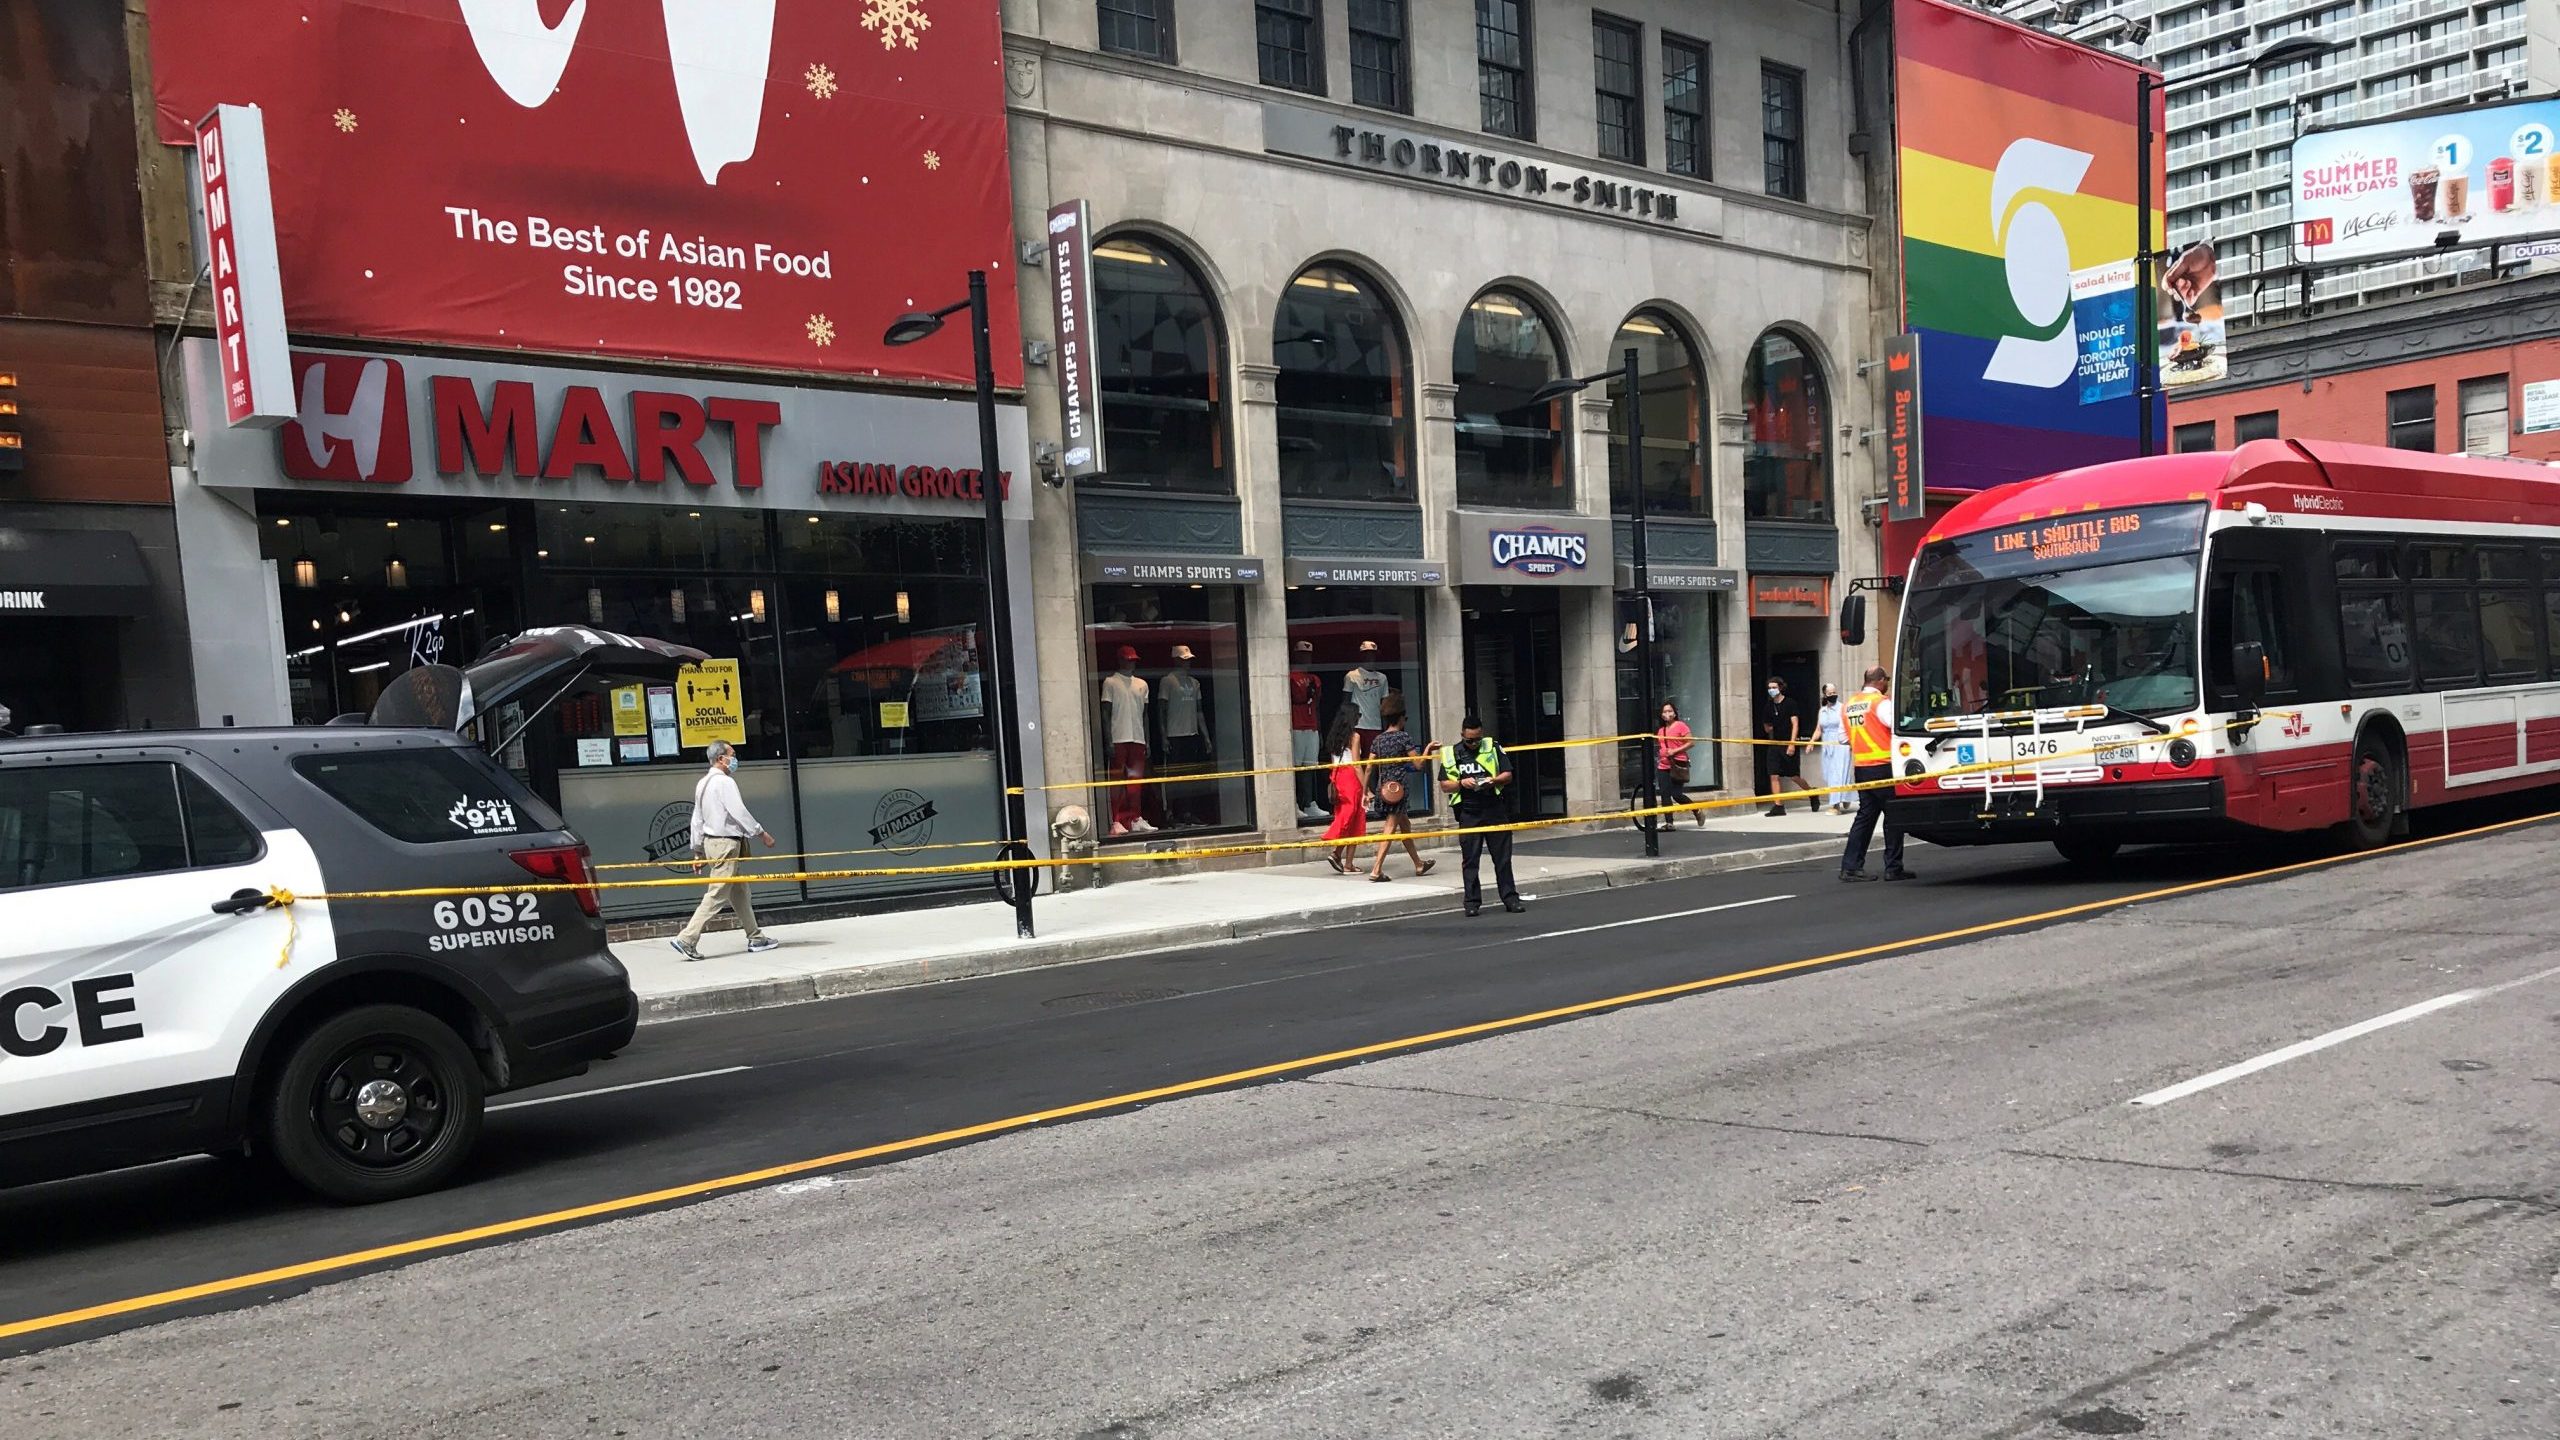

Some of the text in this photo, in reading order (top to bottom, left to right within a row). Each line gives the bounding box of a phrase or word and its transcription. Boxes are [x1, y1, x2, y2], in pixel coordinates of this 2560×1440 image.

[1330, 125, 1680, 221] THORNTON-SMITH
[2303, 157, 2398, 187] SUMMER
[2303, 176, 2399, 200] DRINK DAYS
[444, 206, 832, 279] The Best of Asian Food
[209, 186, 240, 373] MART
[563, 264, 743, 310] Since 1982
[2075, 270, 2131, 290] salad king
[1057, 240, 1081, 439] CHAMPS SPORTS
[2079, 324, 2126, 343] INDULGE
[2098, 339, 2111, 350] IN
[2079, 344, 2136, 365] TORONTO'S
[2078, 358, 2127, 376] CULTURAL
[2097, 368, 2130, 384] HEART
[428, 375, 782, 489] MART
[1892, 390, 1912, 508] salad king
[819, 461, 1013, 501] ASIAN GROCEY
[2268, 514, 2284, 526] 3476
[1994, 513, 2141, 552] LINE 1 SHUTTLE BUS
[1493, 533, 1586, 565] CHAMPS
[2033, 537, 2101, 560] SOUTHBOUND
[1133, 565, 1232, 579] CHAMPS SPORTS
[1332, 569, 1417, 582] CHAMPS SPORTS
[1527, 563, 1555, 573] SPORTS
[1652, 575, 1717, 586] CHAMPS SPORTS
[0, 591, 45, 609] RINK
[681, 666, 704, 675] THANK
[719, 665, 733, 673] FOR
[686, 716, 738, 726] DISTANCING
[695, 707, 727, 716] SOCIAL
[1848, 714, 1865, 727] TTC
[2017, 739, 2058, 757] 3476
[1459, 763, 1486, 775] POLI
[476, 799, 512, 809] CALL
[890, 807, 926, 832] MART
[473, 826, 518, 835] EMERGENCY
[433, 891, 540, 930] 60S2
[428, 923, 555, 953] SUPERVISOR
